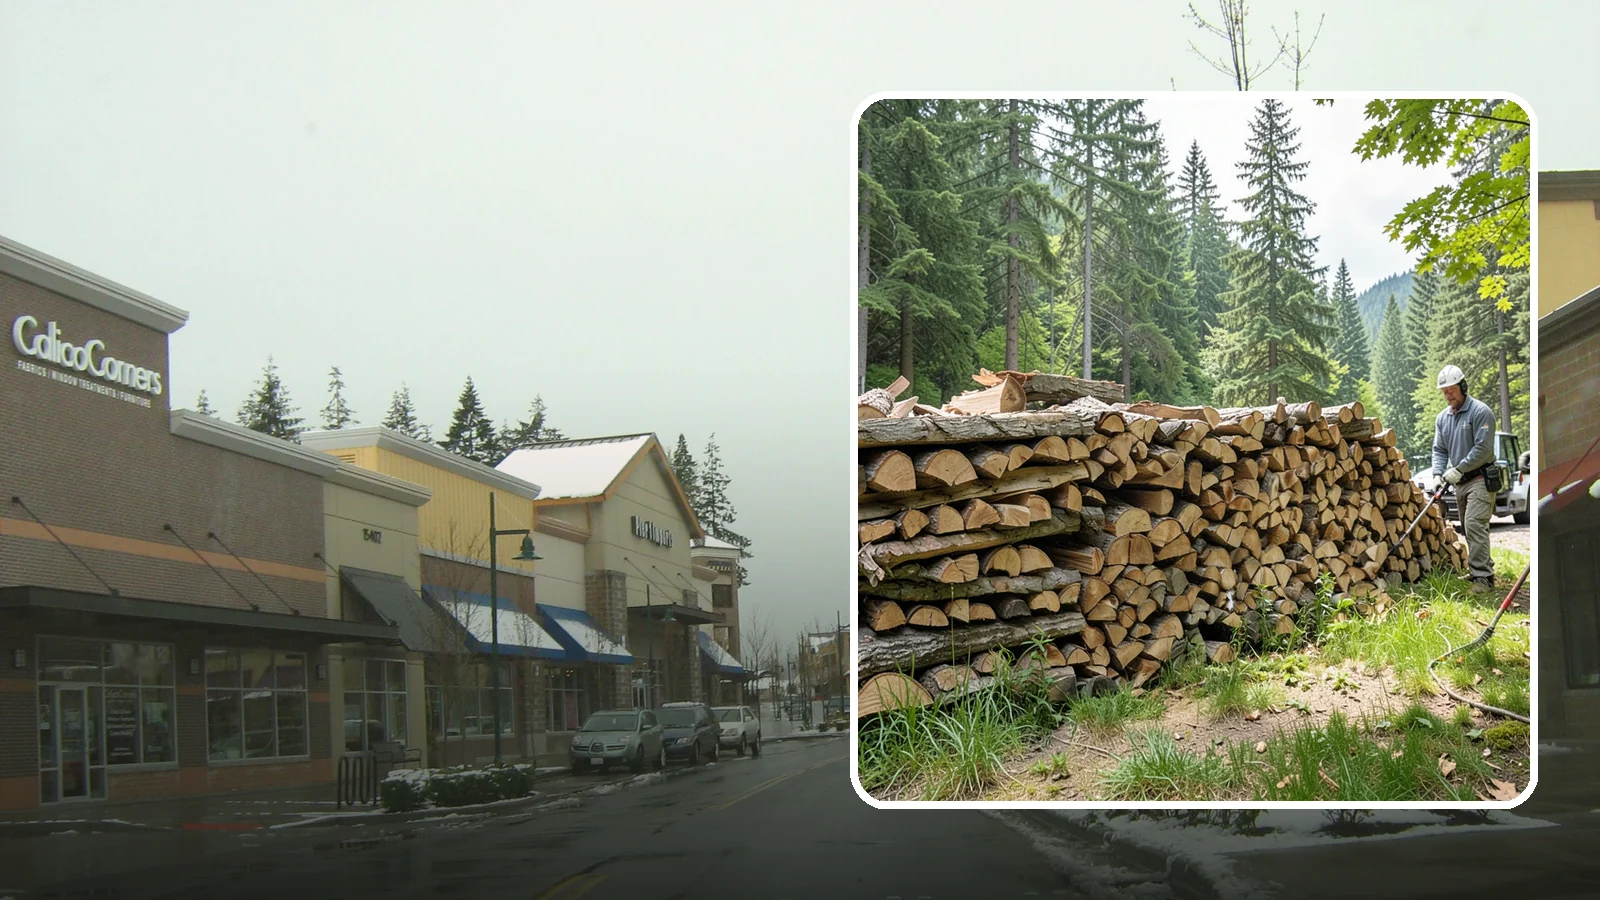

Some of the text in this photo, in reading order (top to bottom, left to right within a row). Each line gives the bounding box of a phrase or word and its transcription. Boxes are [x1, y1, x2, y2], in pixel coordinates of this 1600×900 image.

[17, 359, 47, 377] FABRICS
[51, 369, 77, 386] WINDOW
[78, 378, 117, 399] TREATMENTS
